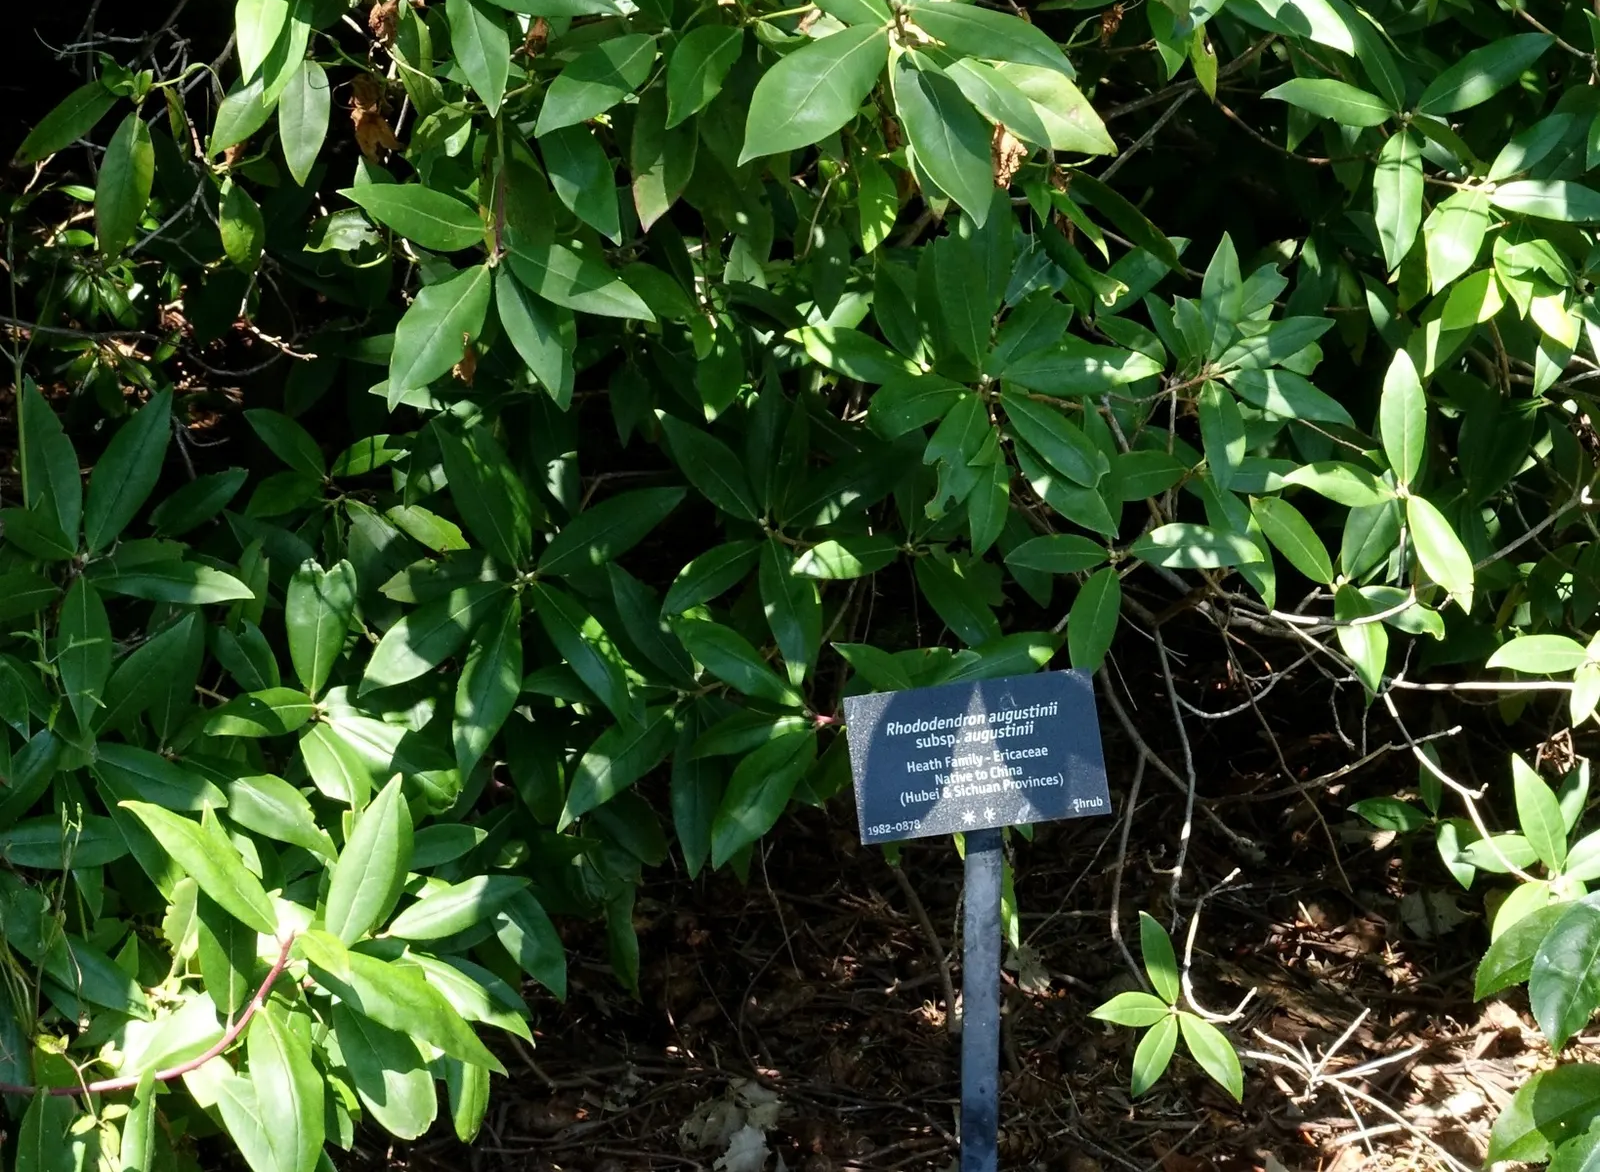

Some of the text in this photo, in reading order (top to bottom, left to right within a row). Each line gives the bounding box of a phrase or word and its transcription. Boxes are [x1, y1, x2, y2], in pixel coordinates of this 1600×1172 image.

[886, 702, 1058, 737] Rhododendron augustinii
[916, 721, 1034, 749] subsp. augustinii
[907, 758, 942, 773] Heath
[945, 753, 983, 769] Family
[993, 746, 1048, 763] Ericaceae
[935, 765, 1023, 785] Native to China
[901, 772, 1064, 807] (Hubei & Sichuan Provinces)
[1073, 796, 1103, 810] Shrub
[868, 819, 921, 835] 1982-0878
